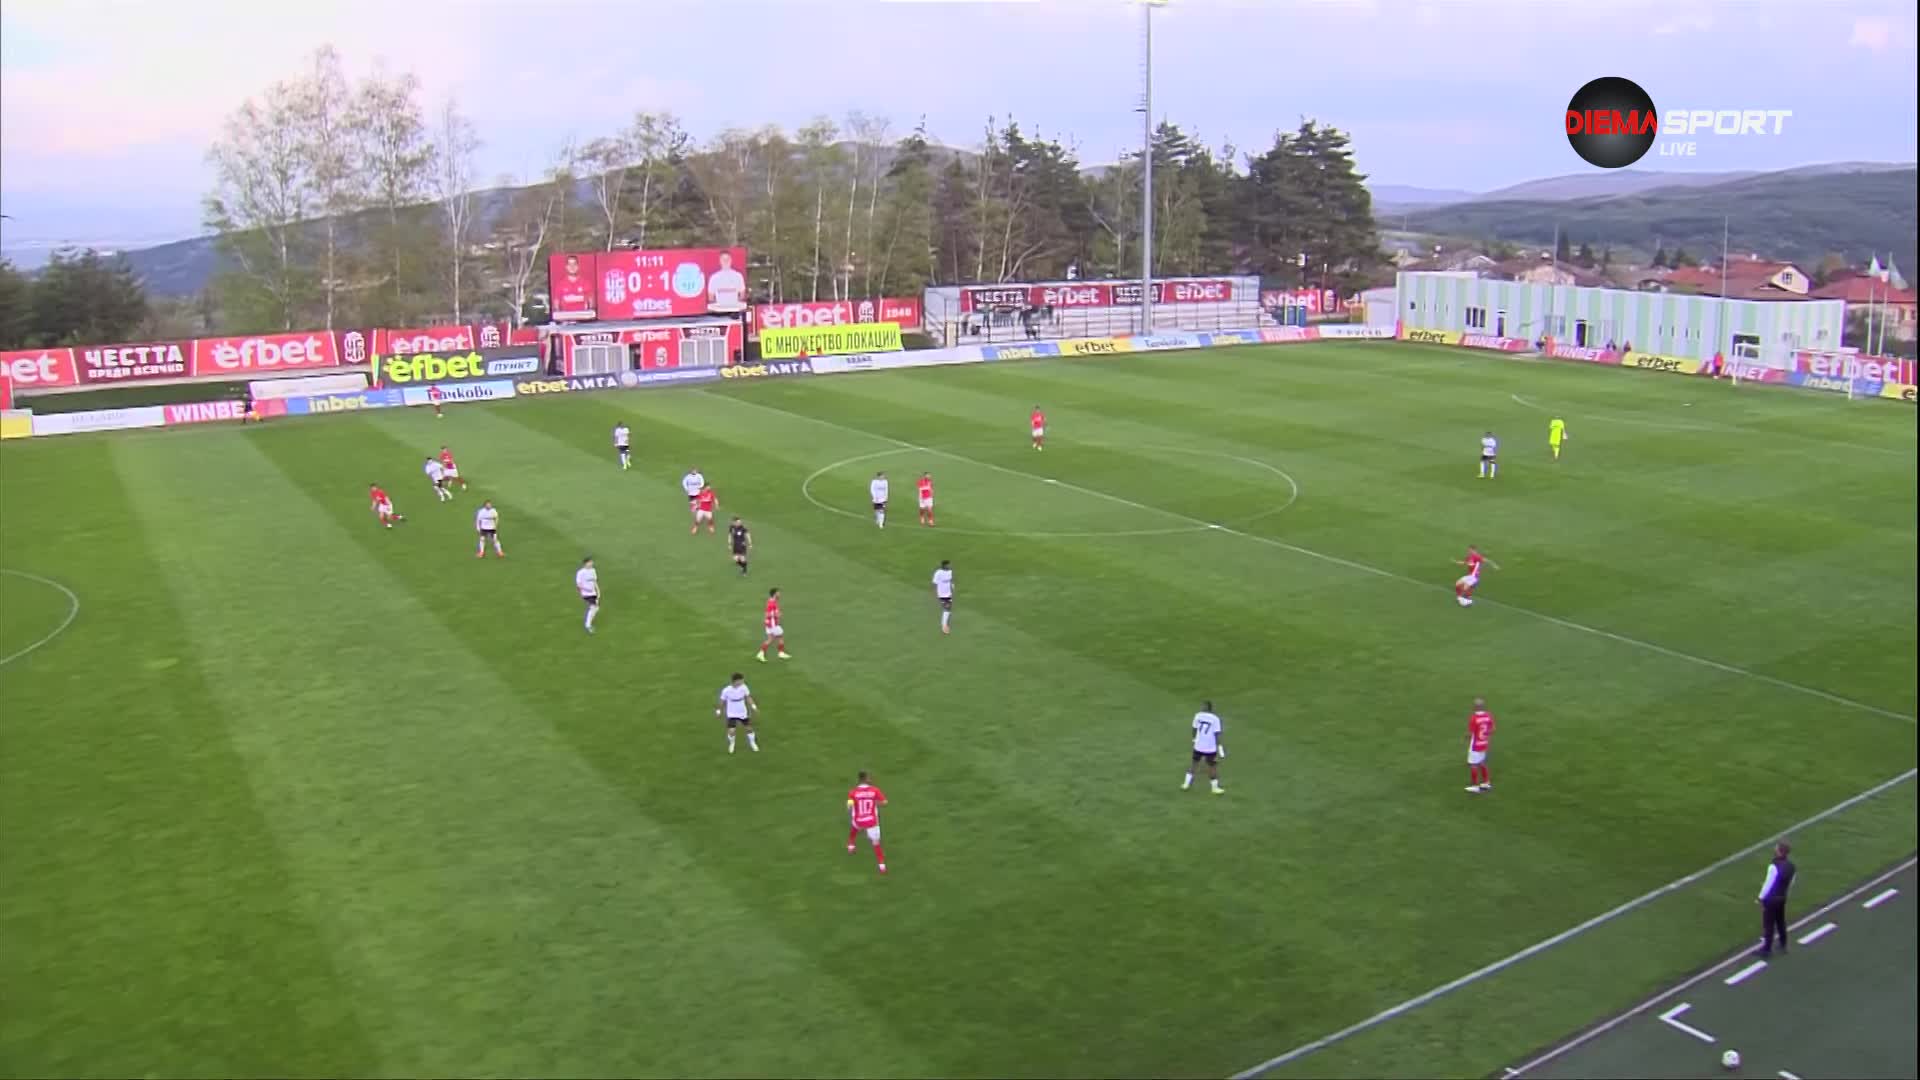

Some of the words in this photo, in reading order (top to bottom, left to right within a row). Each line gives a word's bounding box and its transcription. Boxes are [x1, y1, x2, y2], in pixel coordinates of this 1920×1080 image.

[634, 256, 664, 267] 11:11
[1043, 288, 1099, 304] efbet
[1175, 284, 1224, 300] efbet
[761, 304, 846, 328] efbet
[391, 334, 467, 354] efbet
[776, 331, 841, 353] МНОЖЕСТВО
[846, 328, 897, 350] ЛОКАЦИИ
[1409, 330, 1447, 343] efbet
[85, 345, 184, 367] ЧЕСТТА
[212, 333, 323, 369] efbet
[1074, 341, 1116, 353] efbet
[88, 367, 130, 379] ПРЕДИ
[133, 363, 184, 376] ВСИЧКО
[386, 351, 485, 382] efbet
[720, 364, 768, 379] efbet
[767, 360, 812, 374] ЛИГА
[1637, 355, 1681, 371] efbet
[1812, 354, 1897, 382] efbet
[517, 380, 568, 394] efbet
[569, 375, 618, 390] ЛИГА
[309, 395, 369, 413] inbet
[1199, 721, 1211, 735] 77
[858, 800, 873, 815] 10
